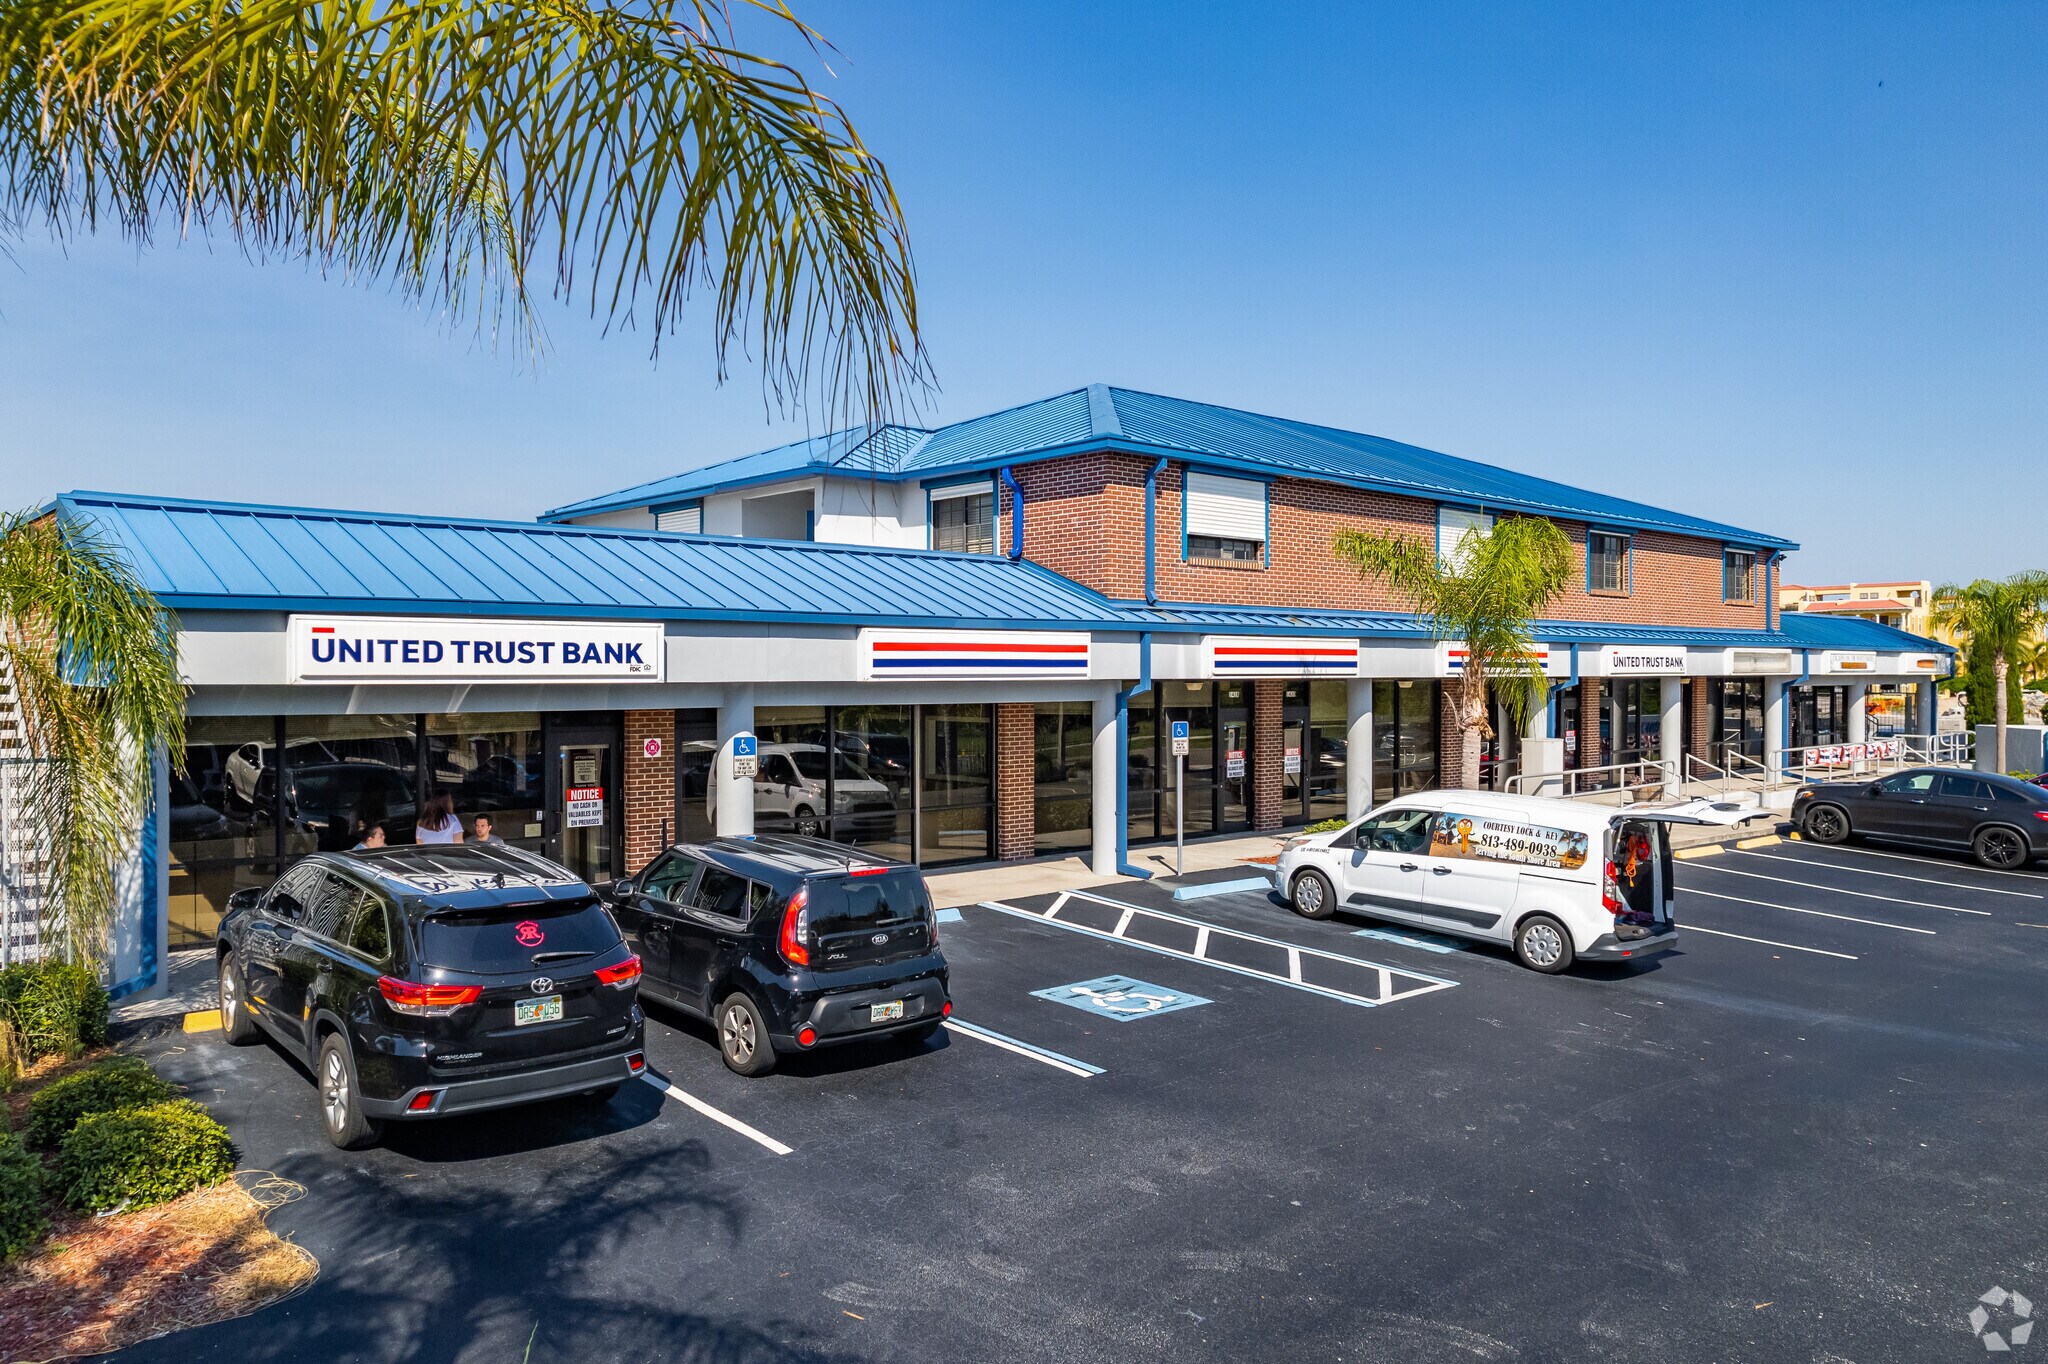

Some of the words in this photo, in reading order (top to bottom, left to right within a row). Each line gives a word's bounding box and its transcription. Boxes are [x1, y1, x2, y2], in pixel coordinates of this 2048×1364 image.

[312, 638, 444, 663] UNITED
[450, 640, 555, 664] TRUST
[562, 642, 644, 664] BANK
[1613, 656, 1640, 667] UNITED
[1641, 657, 1664, 667] TRUST
[1665, 657, 1684, 667] BANK
[570, 789, 600, 800] NOTICE
[1483, 821, 1516, 835] COURTESY
[1516, 826, 1534, 836] LOCK
[1545, 830, 1558, 840] KEY
[1480, 834, 1558, 858] 813-489-0938
[1475, 847, 1498, 859] Serving
[1527, 855, 1545, 866] Shore
[1546, 858, 1561, 868] Area
